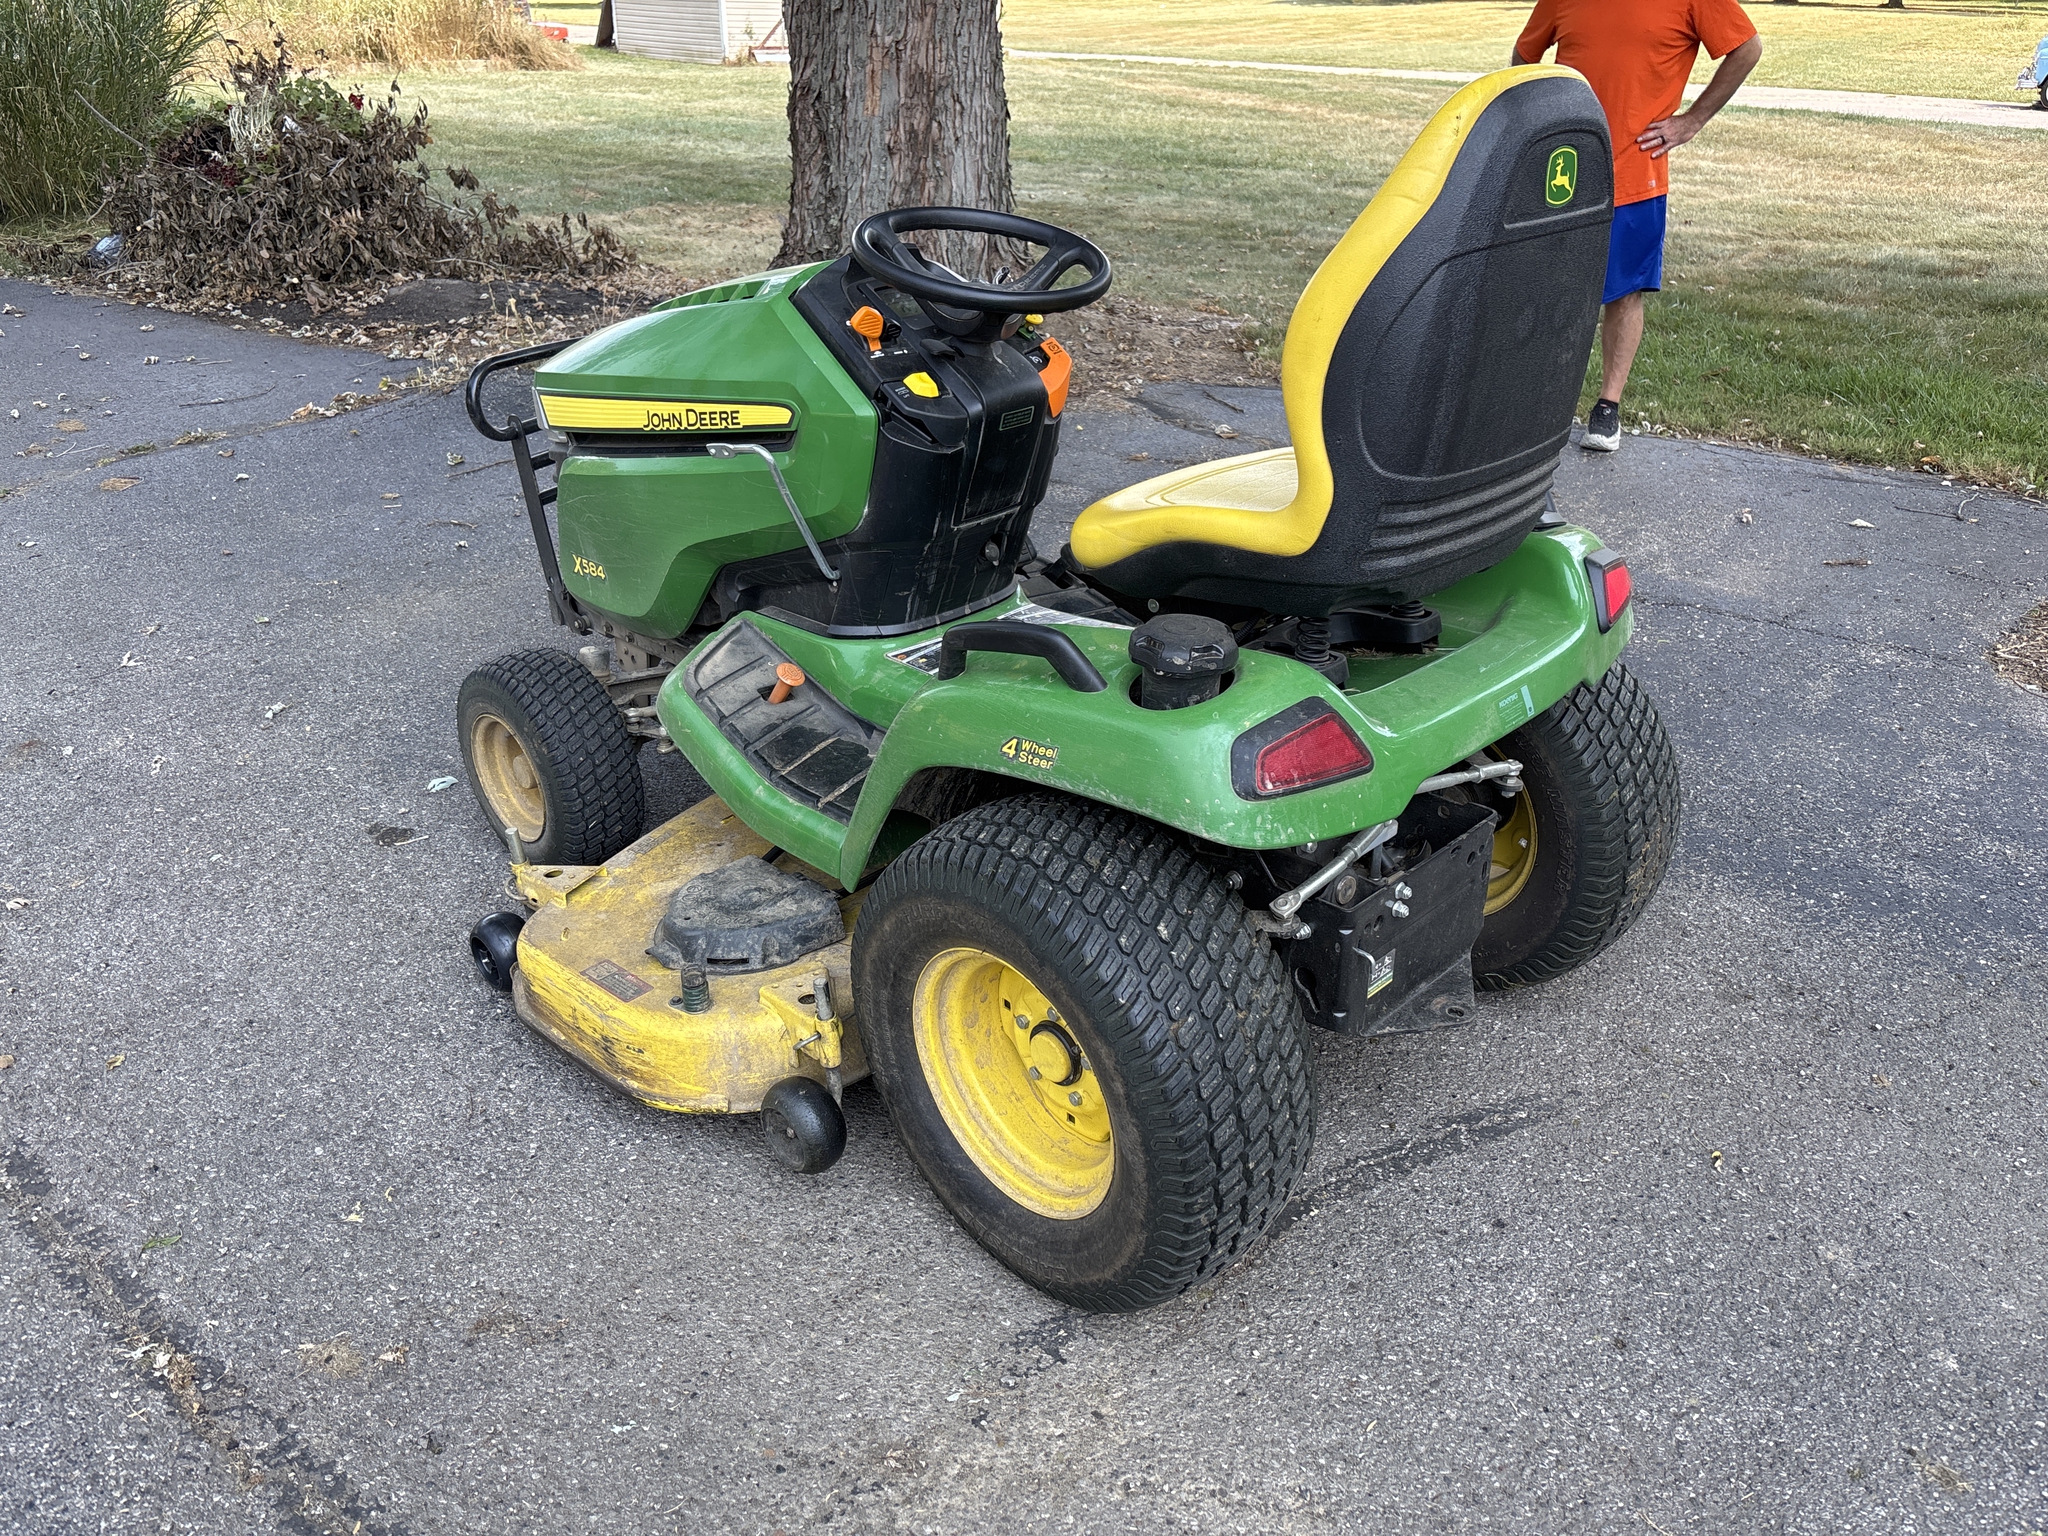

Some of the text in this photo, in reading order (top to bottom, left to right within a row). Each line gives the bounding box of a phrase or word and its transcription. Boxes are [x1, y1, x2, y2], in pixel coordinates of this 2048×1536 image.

[643, 409, 740, 428] JOHN DEERE
[572, 554, 606, 580] X584
[1001, 738, 1018, 758] 4
[1021, 739, 1058, 759] Wheel
[1018, 751, 1054, 769] Steer
